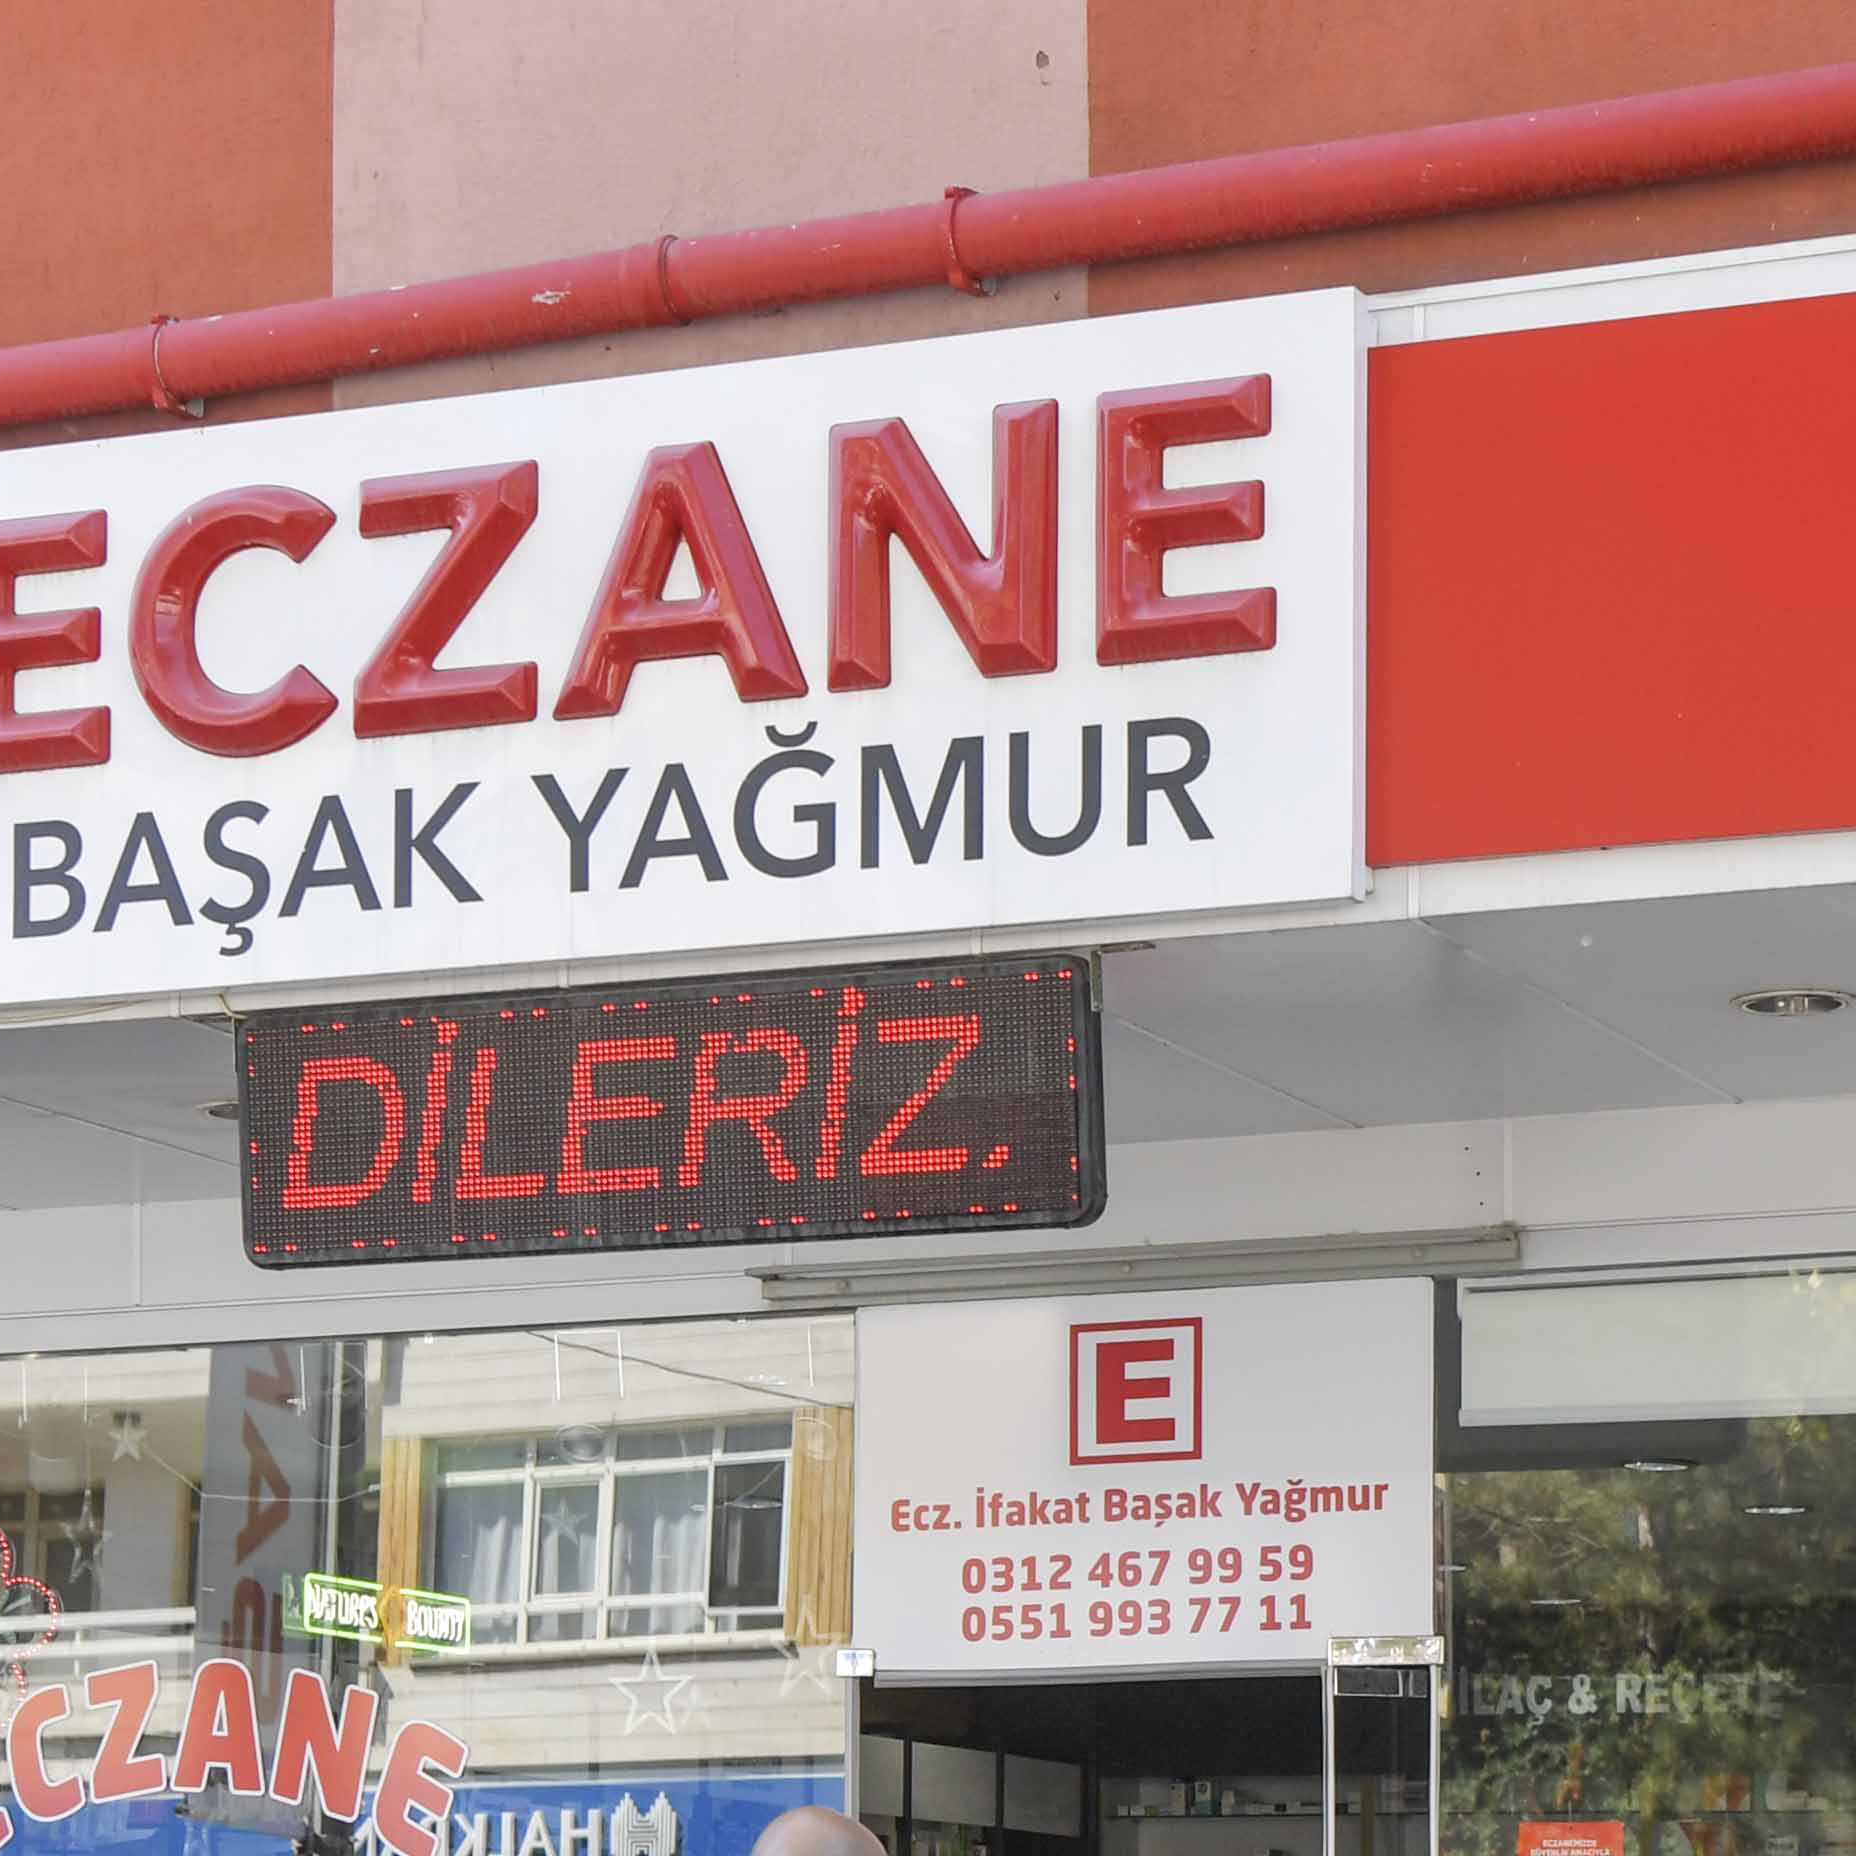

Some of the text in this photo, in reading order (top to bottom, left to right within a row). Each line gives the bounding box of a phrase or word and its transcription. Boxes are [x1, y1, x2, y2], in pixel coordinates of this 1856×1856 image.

[11, 715, 1216, 956] BAŞAK YAĞMUR
[1096, 1338, 1175, 1444] E
[890, 1479, 1389, 1532] Ecz. İfakat Başak Yağmur
[961, 1544, 1314, 1594] 0312 467 99 59
[961, 1594, 1312, 1642] 0551 993 77 11
